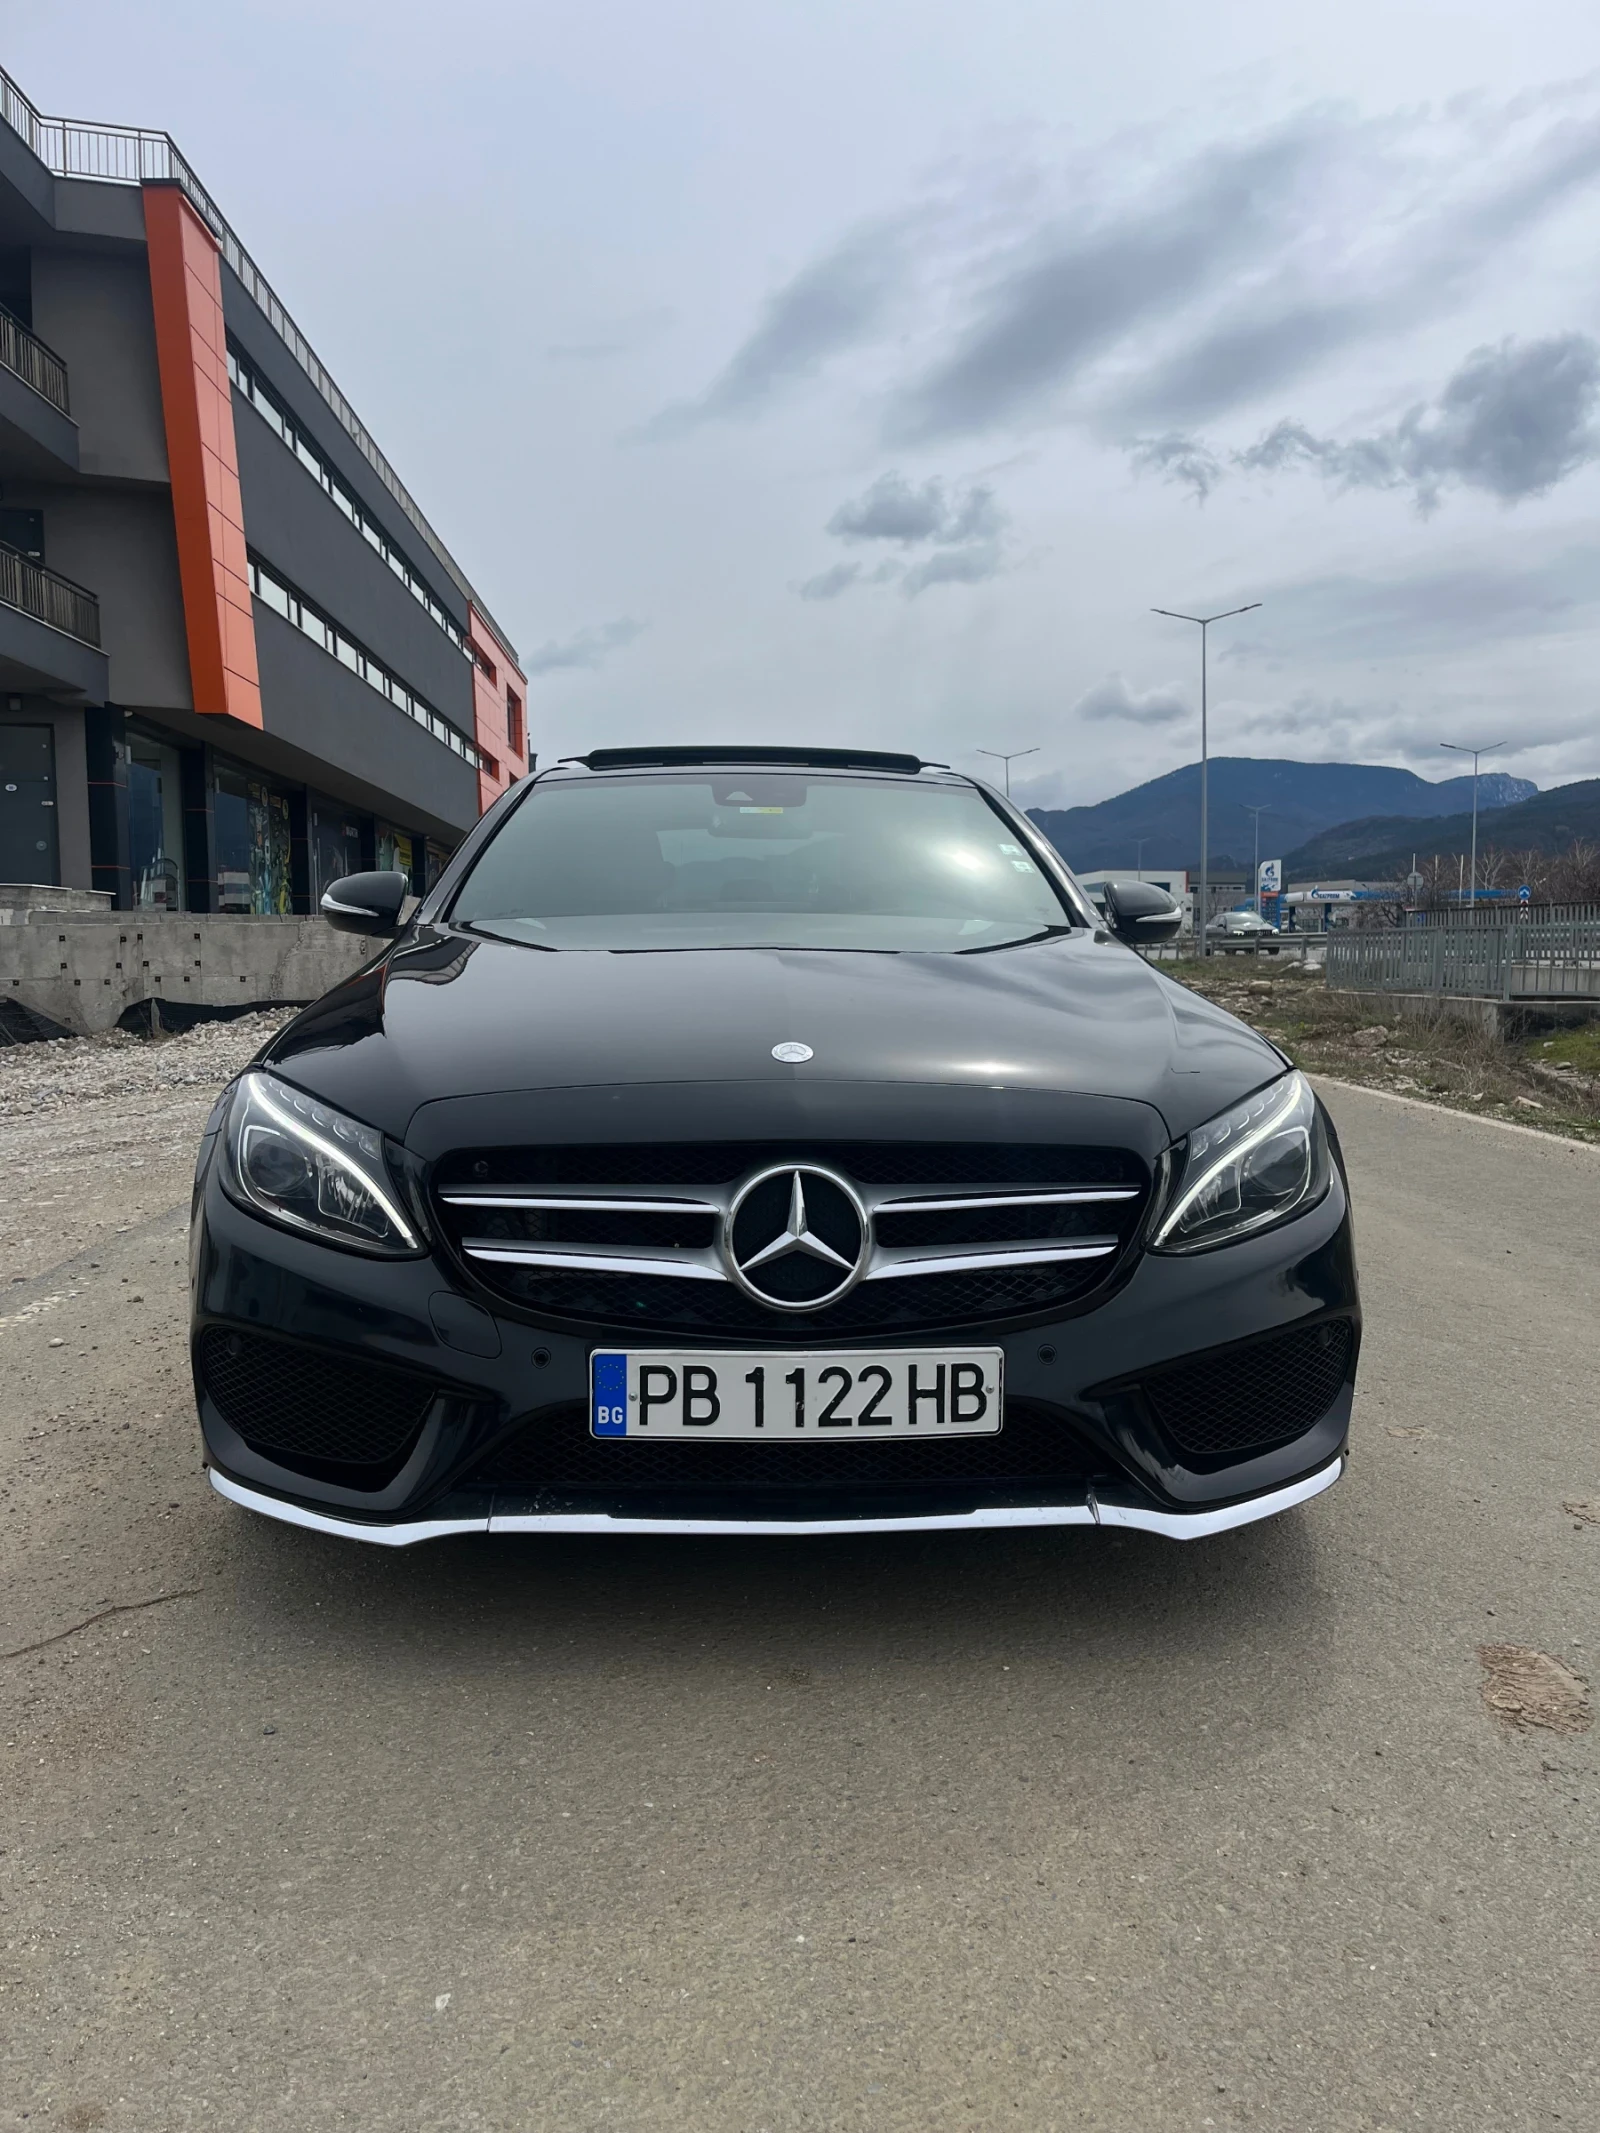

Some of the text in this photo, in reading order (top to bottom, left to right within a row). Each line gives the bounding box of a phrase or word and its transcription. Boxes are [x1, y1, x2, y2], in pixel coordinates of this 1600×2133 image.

[597, 1406, 624, 1424] BG
[639, 1363, 988, 1428] PB 1122 HB
